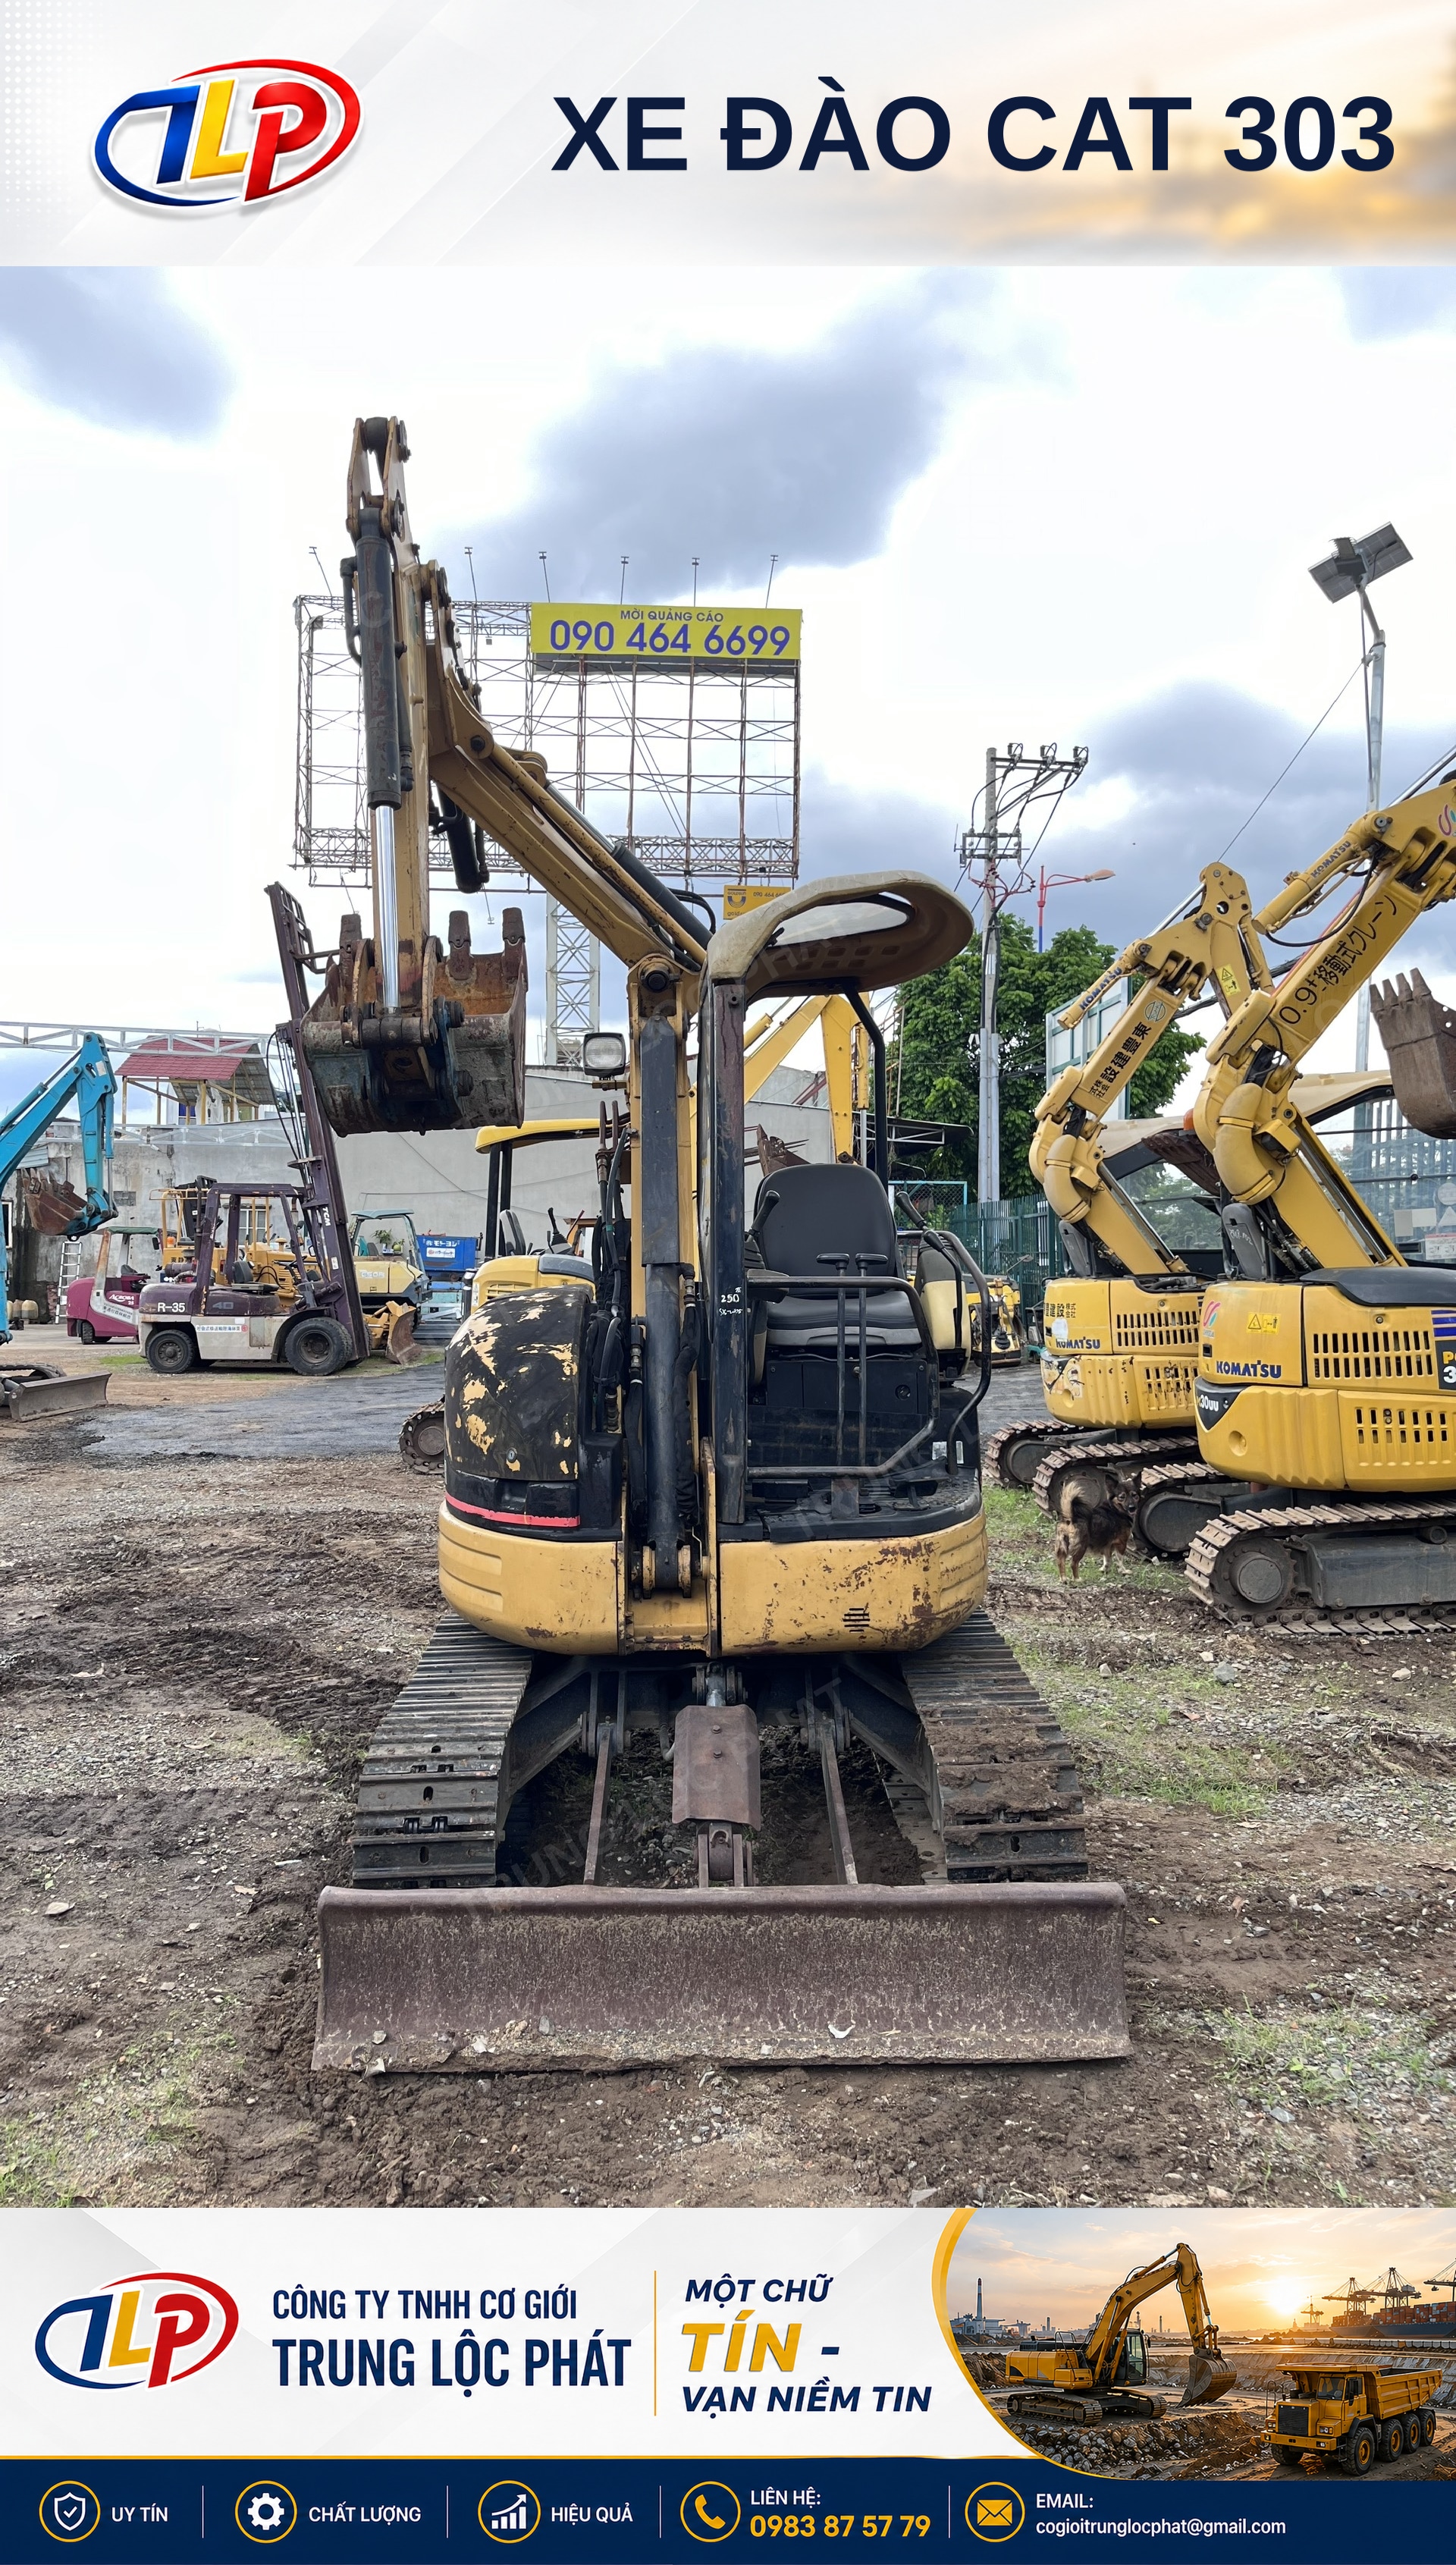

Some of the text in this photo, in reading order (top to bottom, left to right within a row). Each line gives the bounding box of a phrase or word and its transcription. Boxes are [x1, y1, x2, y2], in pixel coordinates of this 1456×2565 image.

[620, 608, 723, 623] MỜI QUẢNG CÁO
[551, 620, 790, 656] 090 464 6699
[1310, 840, 1351, 878] KOMATSU
[1079, 967, 1122, 1010] KOMATSU
[322, 1207, 331, 1226] TCM
[158, 1302, 186, 1313] R-35
[720, 1293, 740, 1304] 250
[1216, 1360, 1282, 1379] KOMATSU
